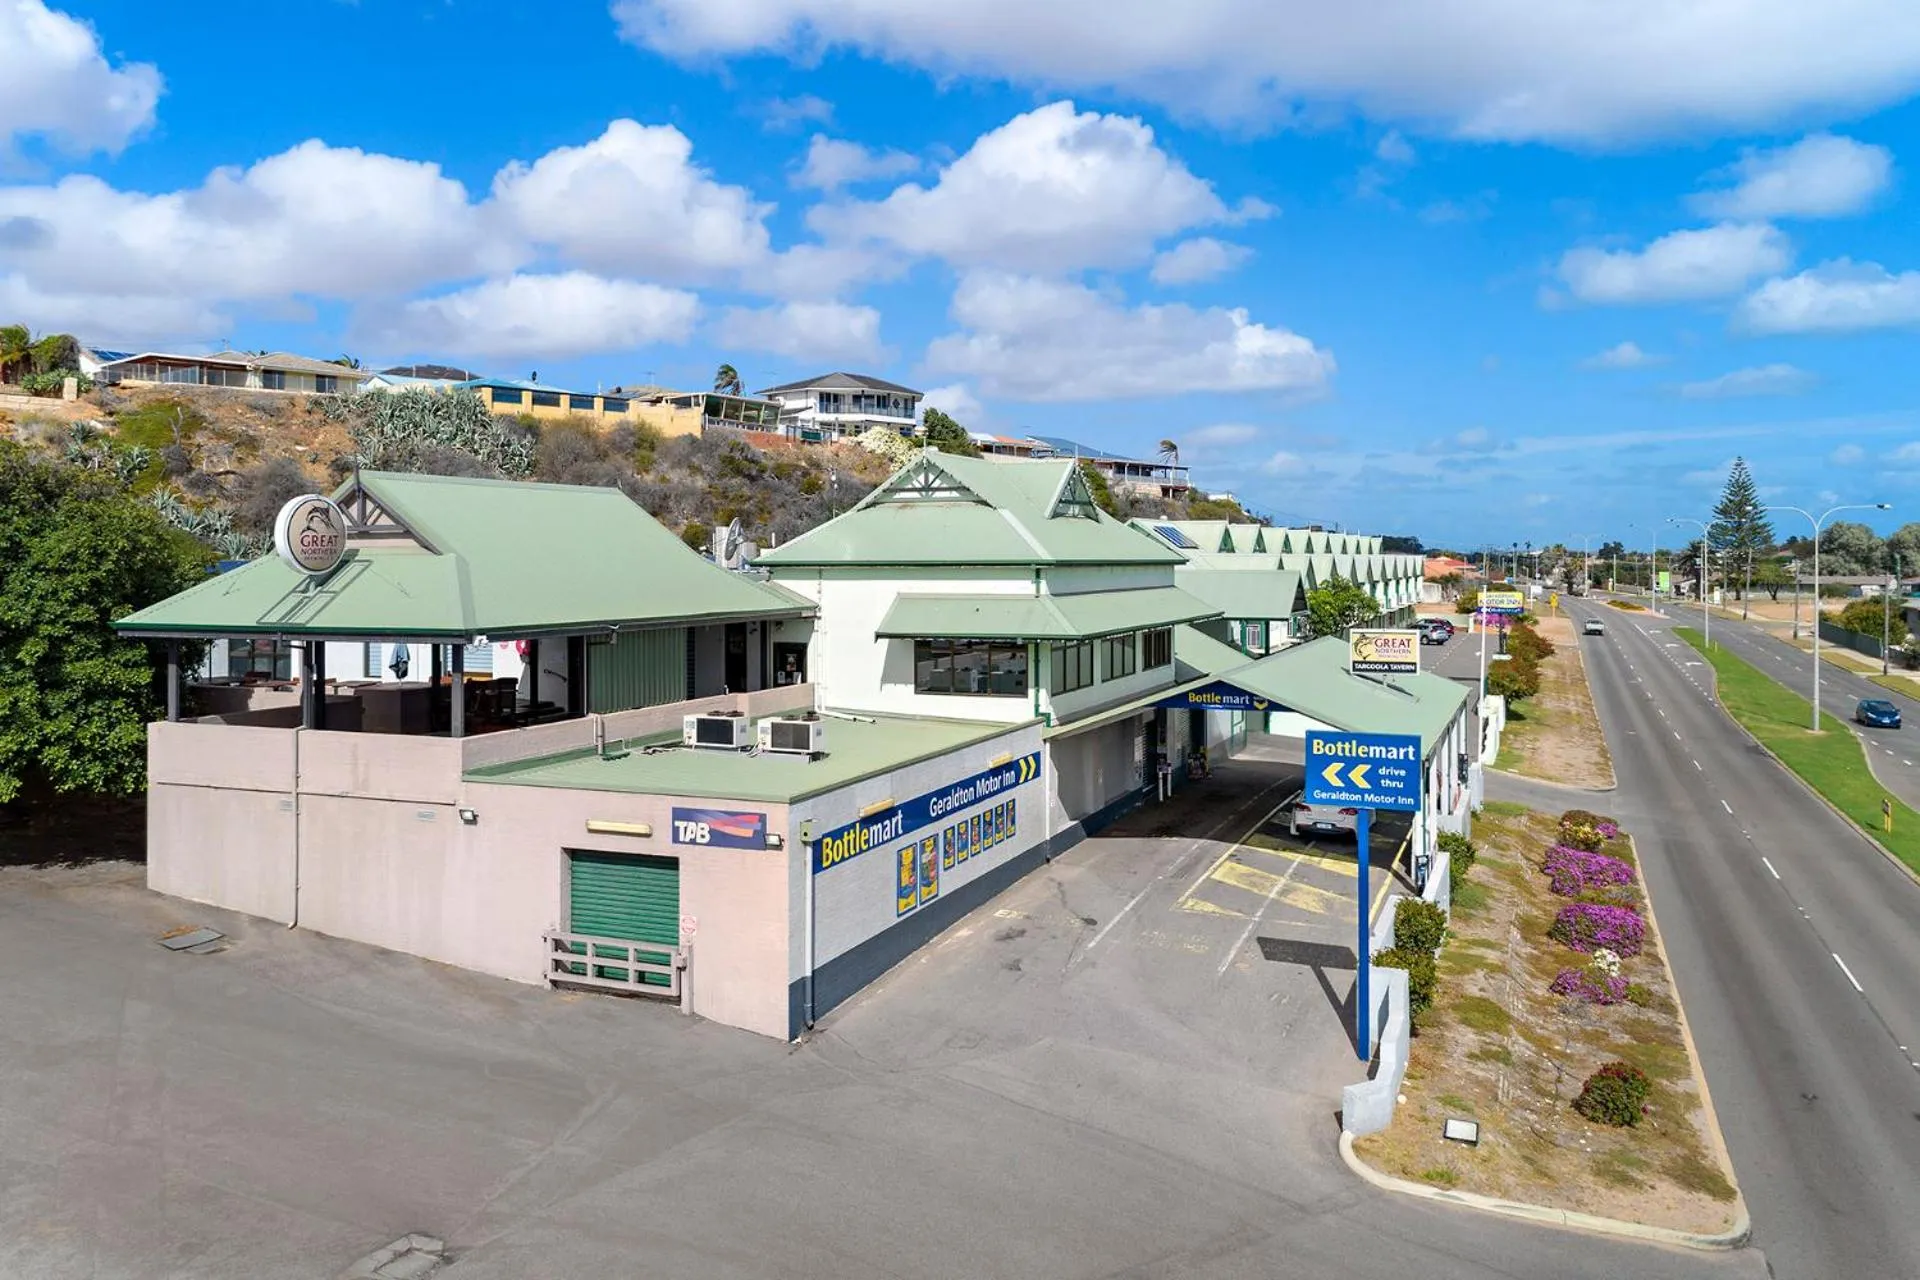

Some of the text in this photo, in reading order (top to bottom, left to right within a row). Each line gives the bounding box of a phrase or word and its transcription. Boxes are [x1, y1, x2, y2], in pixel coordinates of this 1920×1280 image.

[300, 535, 339, 547] GREAT
[1374, 638, 1412, 649] GREAT
[1312, 738, 1415, 761] Bottlemart
[1378, 766, 1407, 777] drive
[1381, 778, 1404, 789] thru
[1313, 789, 1414, 806] Geraldton Motor Inn
[821, 809, 904, 869] Bottlemart
[929, 786, 976, 819] Geraldton
[976, 776, 1002, 801] Motor
[1003, 769, 1016, 790] Inn
[674, 820, 712, 844] TAB
